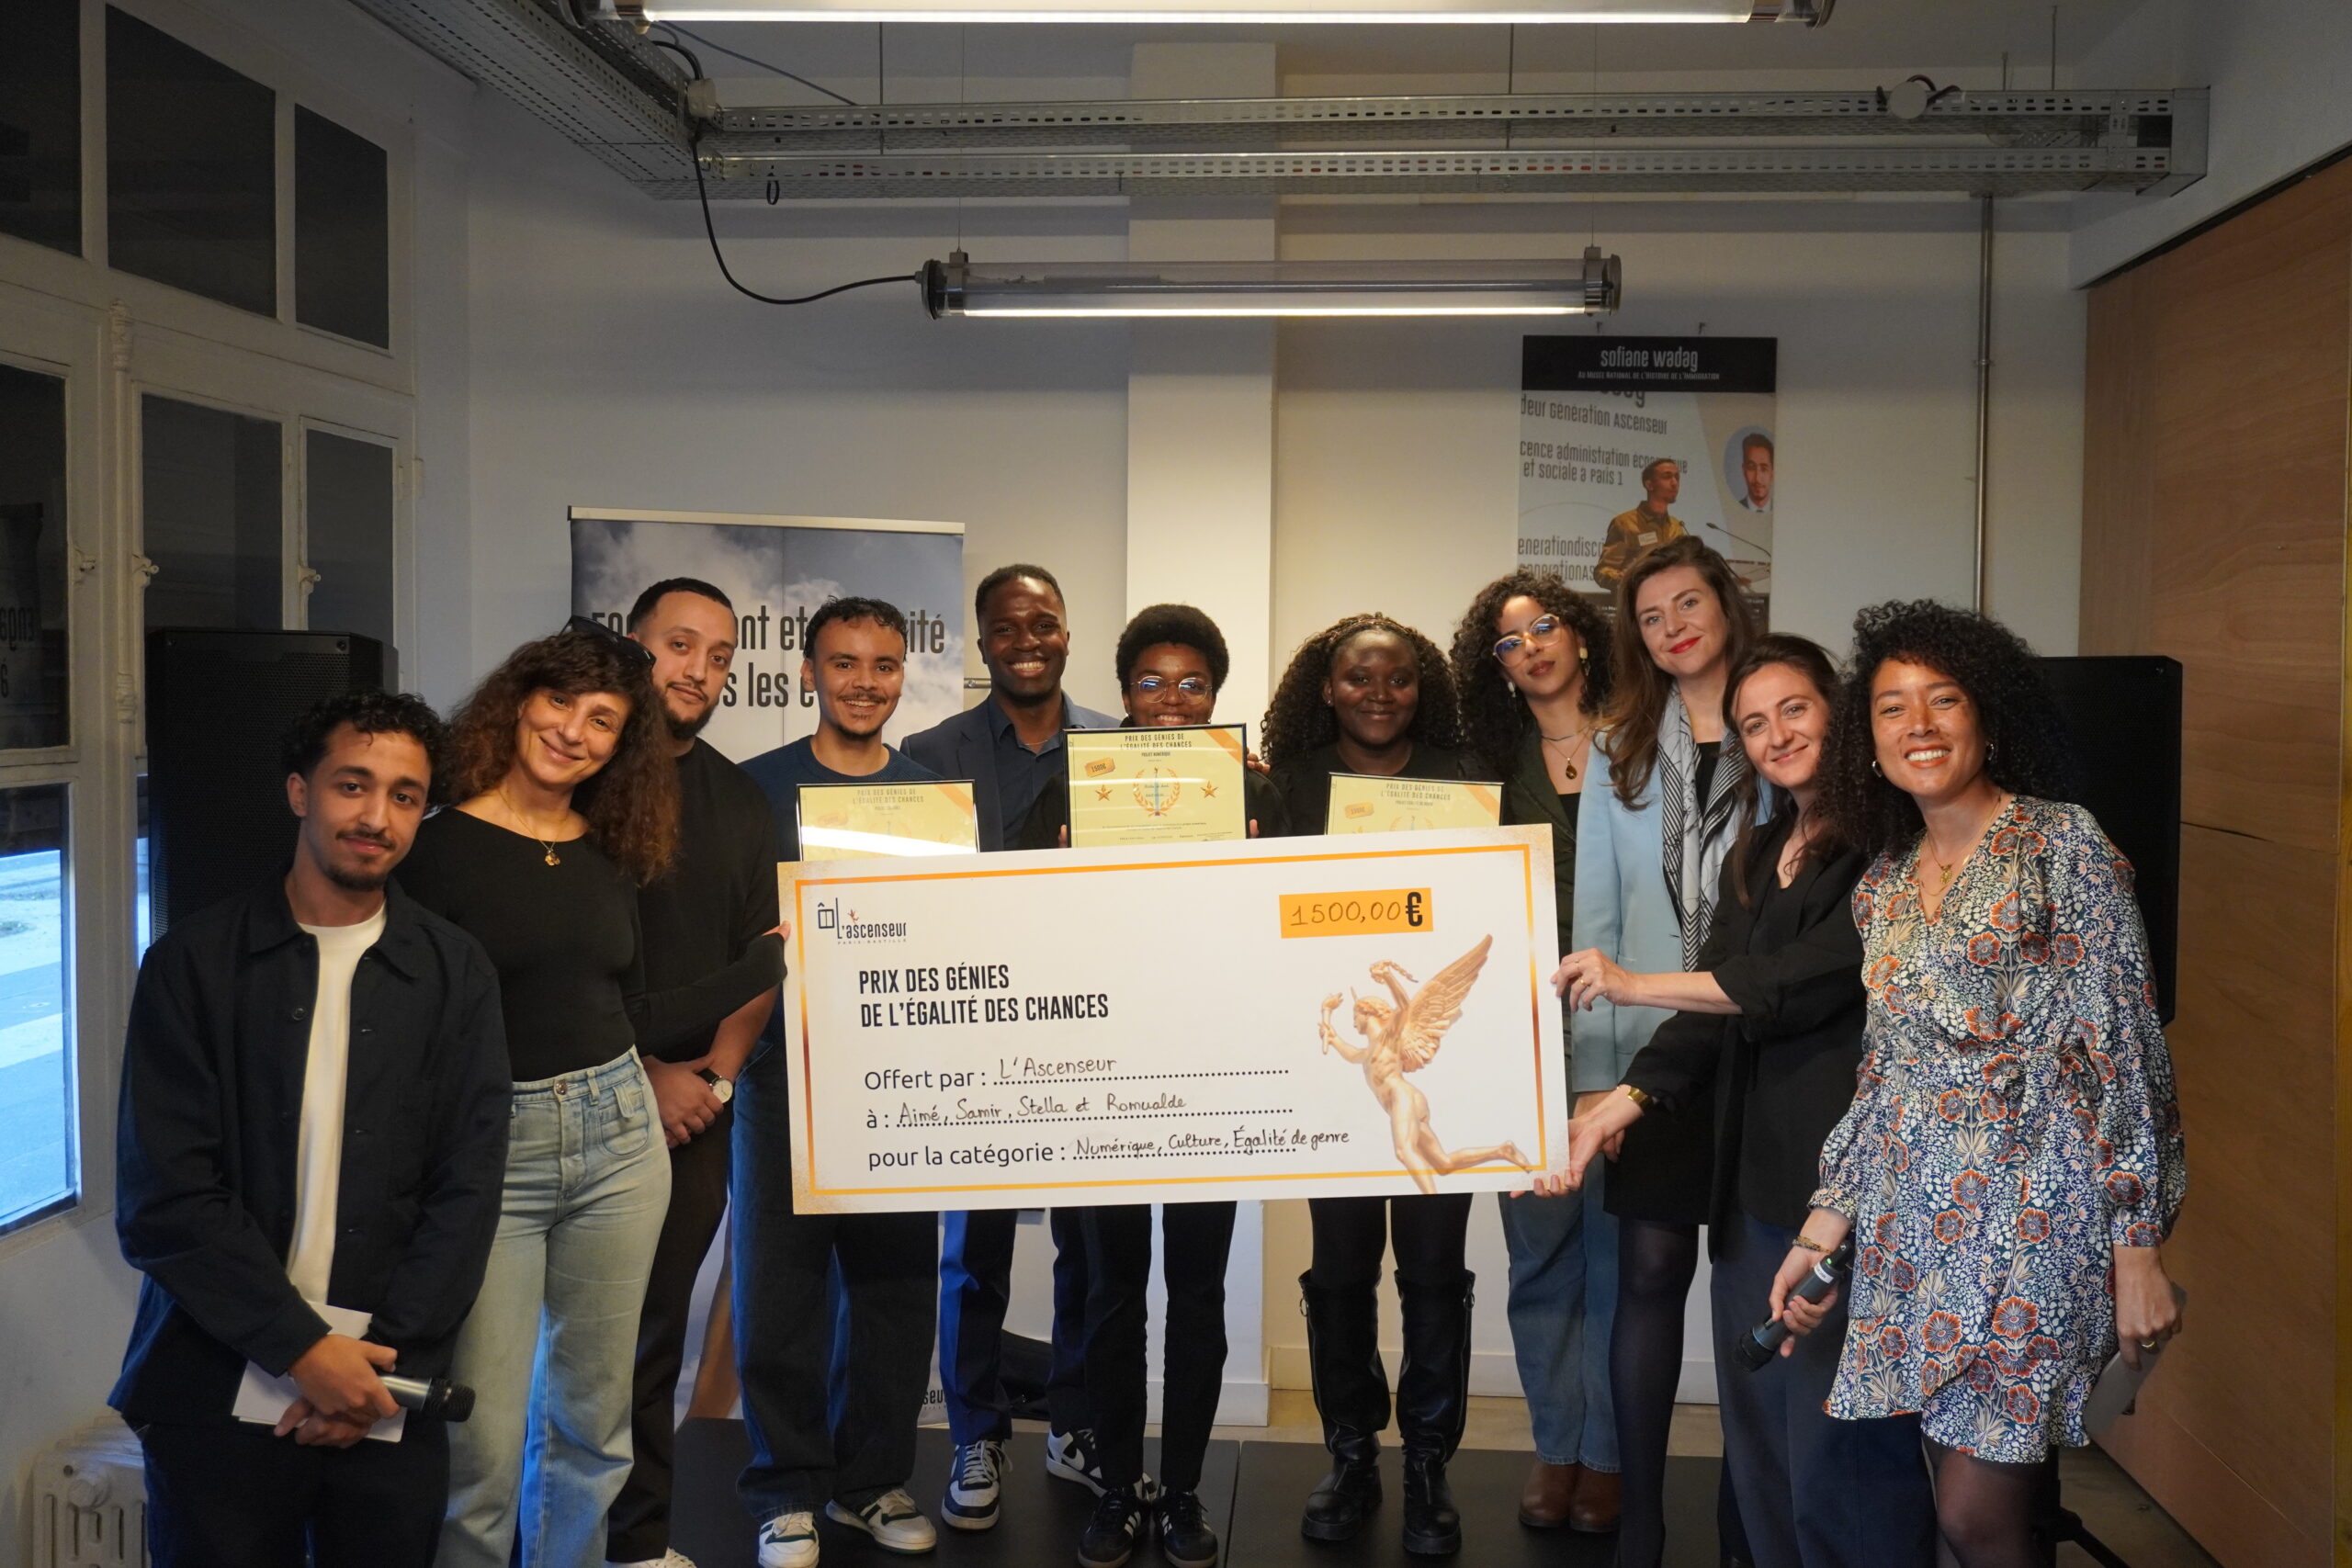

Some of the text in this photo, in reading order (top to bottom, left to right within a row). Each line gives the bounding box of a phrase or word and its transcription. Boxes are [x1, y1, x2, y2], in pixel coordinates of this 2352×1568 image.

[1600, 345, 1698, 372] sofiane wadag
[1556, 443, 1629, 467] administration
[1523, 457, 1534, 477] et
[1539, 461, 1577, 481] sociale
[748, 662, 788, 707] les
[859, 962, 1010, 994] PRIX DES GÉNIES
[861, 993, 1109, 1028] DE L'ÉGALITÉ DES CHANCES
[865, 1068, 933, 1090] Offert
[1000, 1056, 1117, 1079] L'Ascenseur
[1017, 1095, 1068, 1116] Stella
[1075, 1097, 1091, 1112] et
[1106, 1093, 1186, 1112] Romualde
[1233, 1125, 1286, 1156] Égalité
[1291, 1128, 1307, 1145] de
[1311, 1131, 1350, 1150] genre
[869, 1151, 919, 1171] pour
[925, 1145, 943, 1165] la
